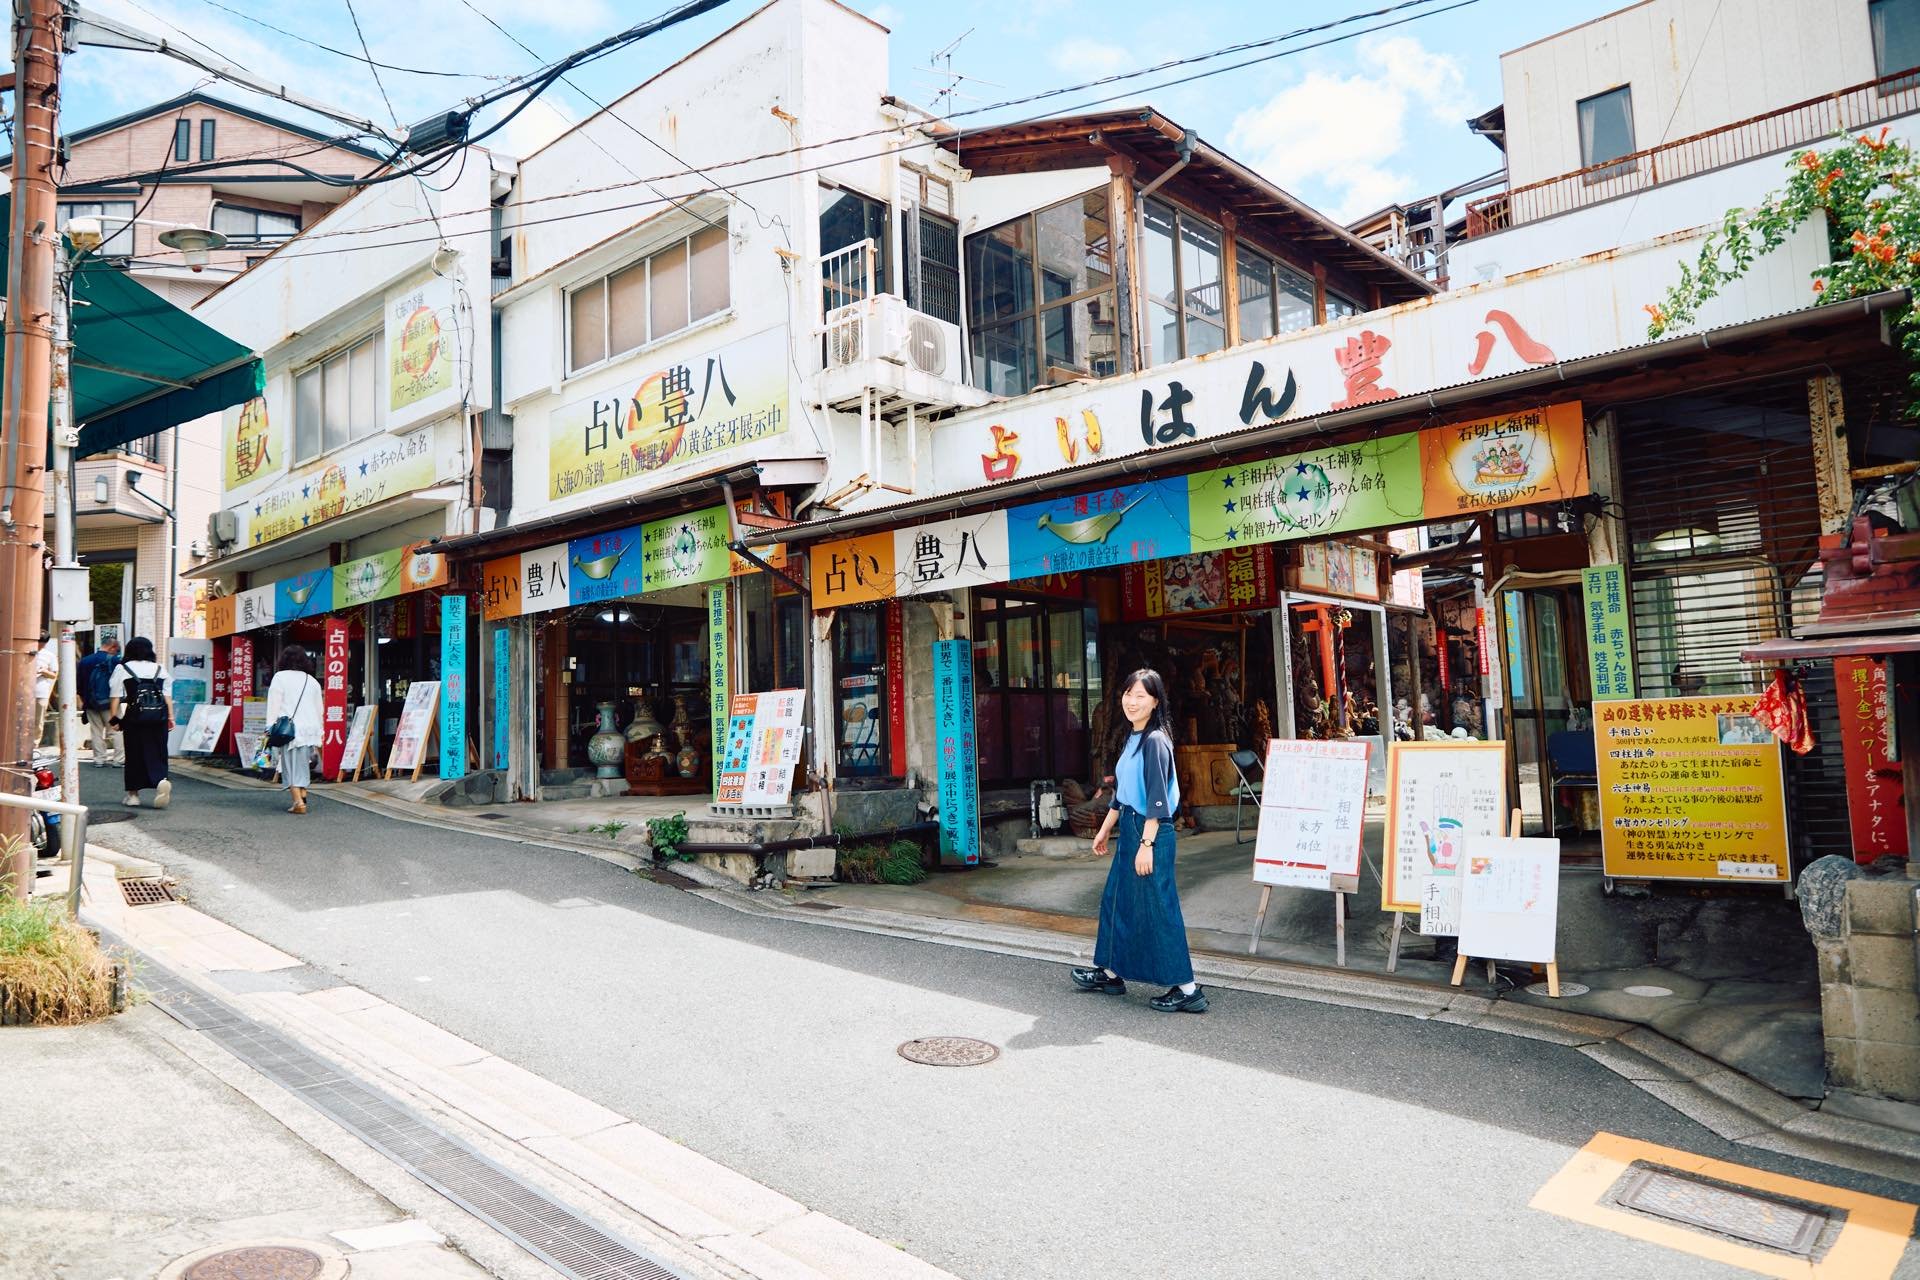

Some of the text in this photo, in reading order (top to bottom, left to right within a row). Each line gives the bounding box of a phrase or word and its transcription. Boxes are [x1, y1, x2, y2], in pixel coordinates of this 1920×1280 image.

[584, 353, 737, 457] 占い 豊八
[1457, 414, 1541, 443] 石切七福神
[235, 433, 271, 481] 豊八
[369, 433, 428, 473] 赤ちゃん命名
[554, 459, 605, 496] 大海の奇跡
[1238, 465, 1286, 487] 手相占い
[1239, 472, 1387, 513] 四柱推命 赤ちゃん命名
[1241, 510, 1340, 540] 神智カウンセリング
[825, 553, 880, 596] 占い
[914, 529, 988, 584] 豊八
[486, 560, 567, 607] 占い 豊八
[211, 606, 230, 631] 占い
[244, 596, 268, 626] 豊八
[713, 590, 723, 626] 四柱推命
[1588, 572, 1611, 695] 五行 気学手相 姓名判断
[1605, 570, 1628, 694] 四柱推命 赤ちゃん命名
[714, 632, 724, 687] 赤ちゃん命名
[325, 628, 345, 745] 占いの館 豊八
[716, 693, 724, 712] 五行
[716, 718, 725, 755] 気学手相
[1609, 727, 1655, 737] 手相占い
[1609, 748, 1655, 759] 四柱推命
[1620, 758, 1763, 769] あなたのもって生まれた宿命と
[1336, 800, 1352, 830] 相性
[1614, 817, 1689, 828] 神智カウンセリング
[1626, 841, 1705, 851] 生きる勇気がわき
[1424, 882, 1441, 921] 手相
